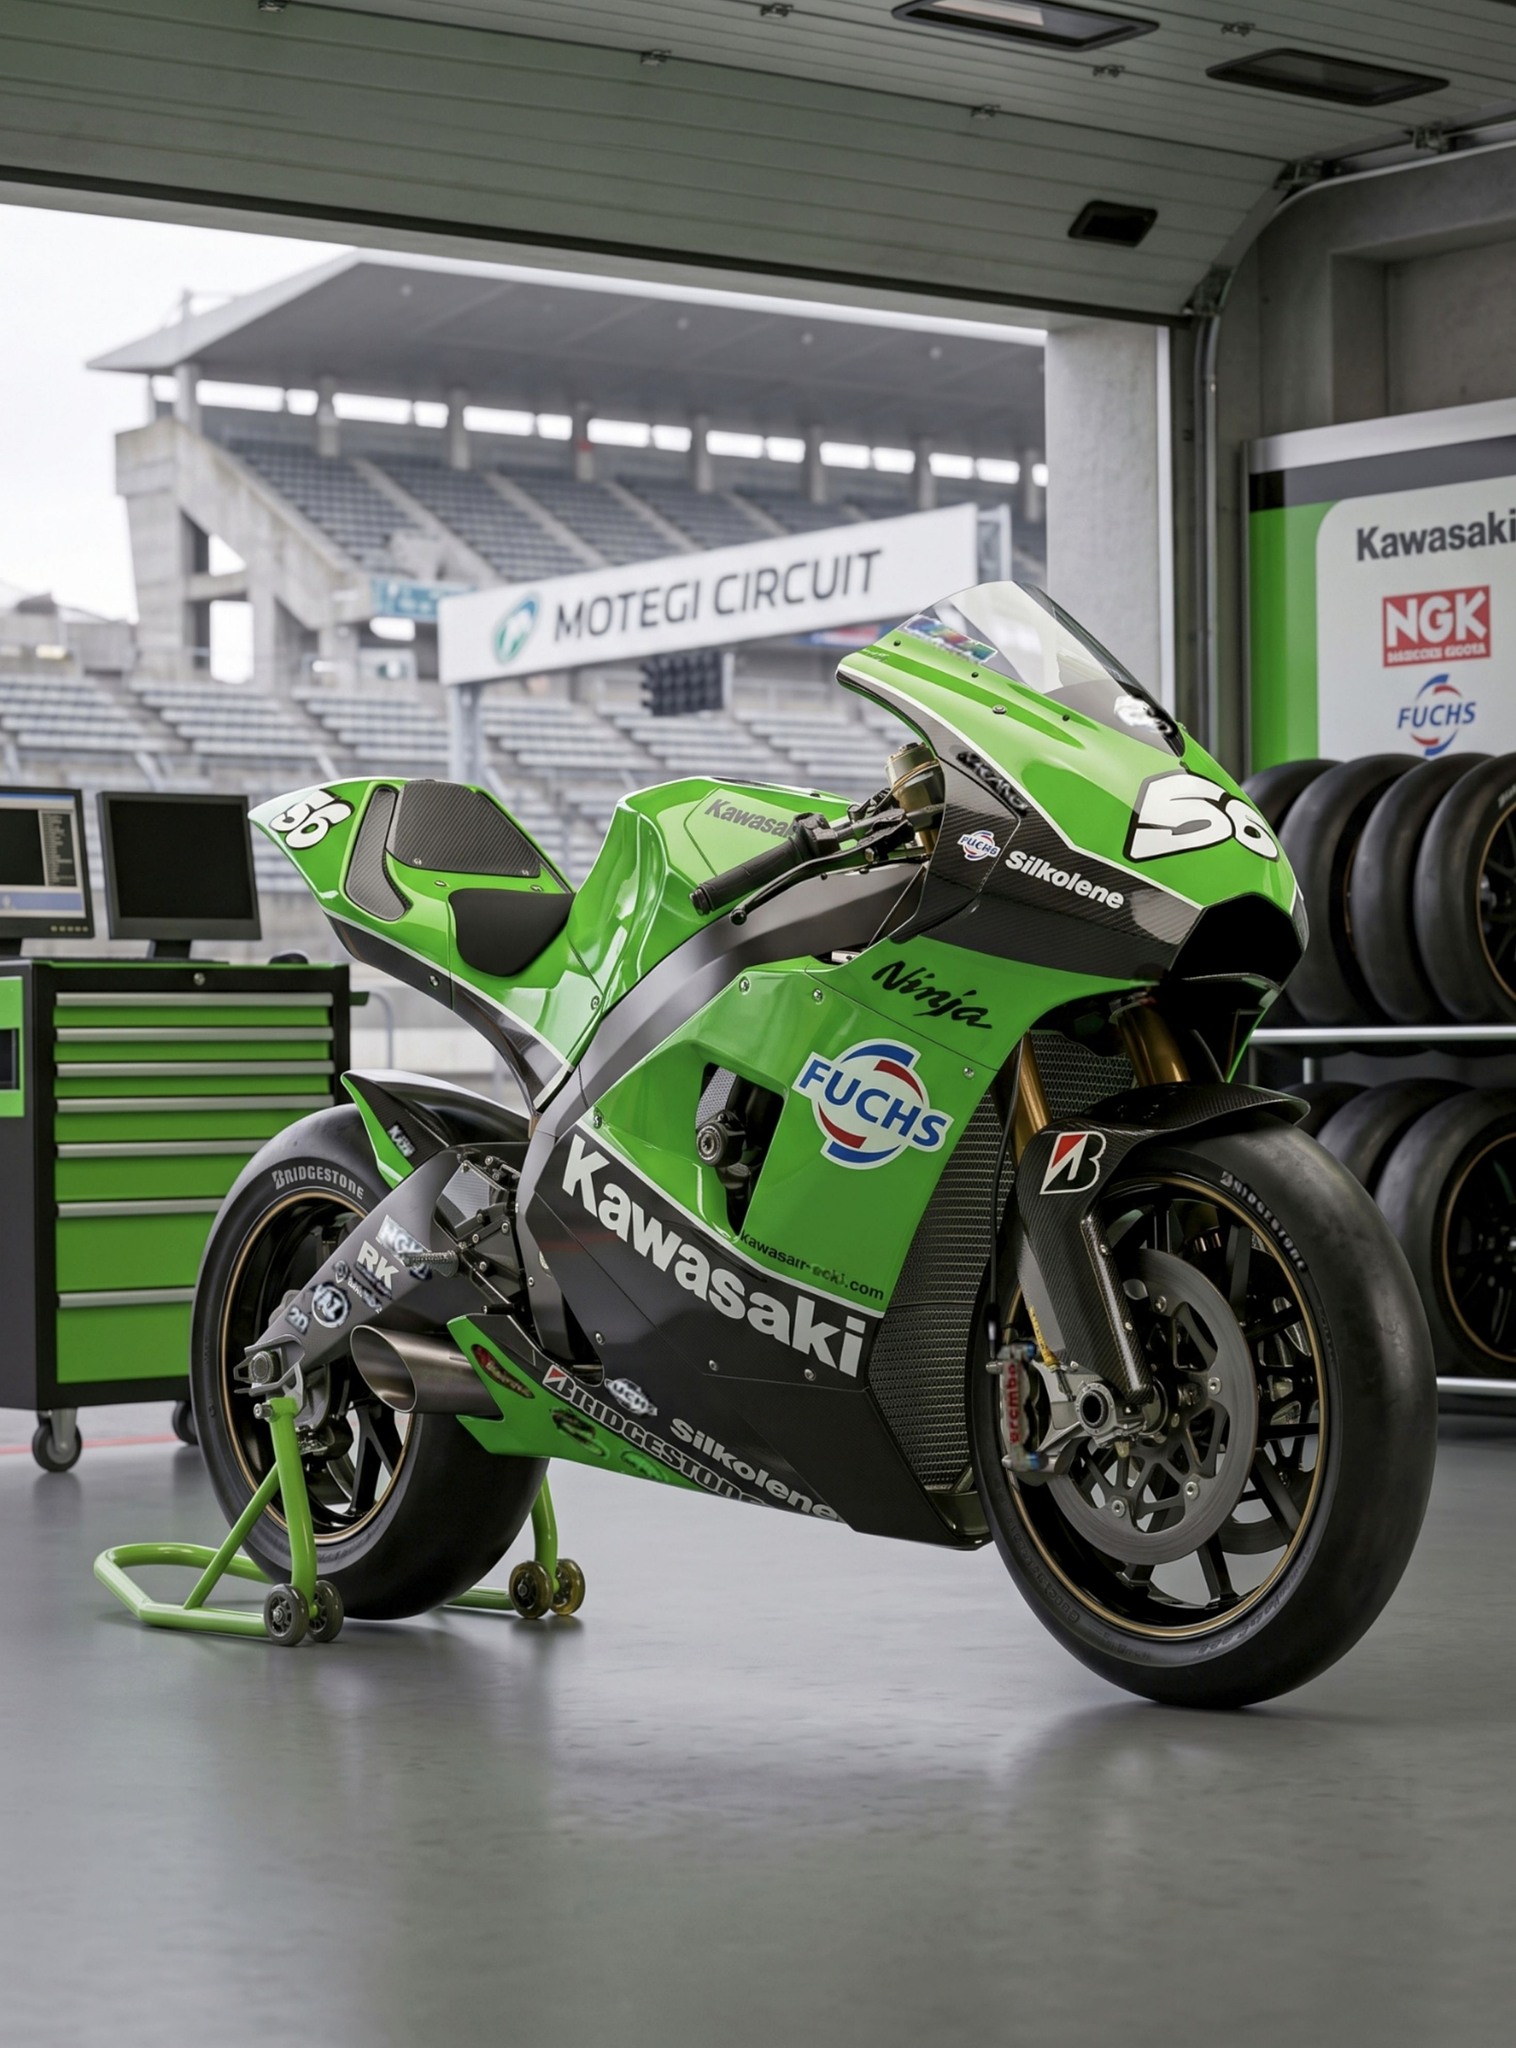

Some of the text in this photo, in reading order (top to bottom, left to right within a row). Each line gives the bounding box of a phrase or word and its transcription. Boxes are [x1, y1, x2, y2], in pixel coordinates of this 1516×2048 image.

[1356, 508, 1516, 562] Kawasaki
[554, 547, 882, 643] MOTEGI CIRCUIT
[1386, 590, 1487, 648] NGK
[1397, 702, 1476, 730] FUCHS
[1128, 774, 1279, 861] 56
[1005, 851, 1124, 909] Silkolene
[871, 960, 993, 1029] Ninja
[799, 1059, 947, 1147] FUCHS
[357, 1240, 399, 1291] RK
[562, 1134, 867, 1378] Kawasaki
[542, 1365, 765, 1505] BRIDGESTON
[670, 1418, 840, 1521] Silkolene
